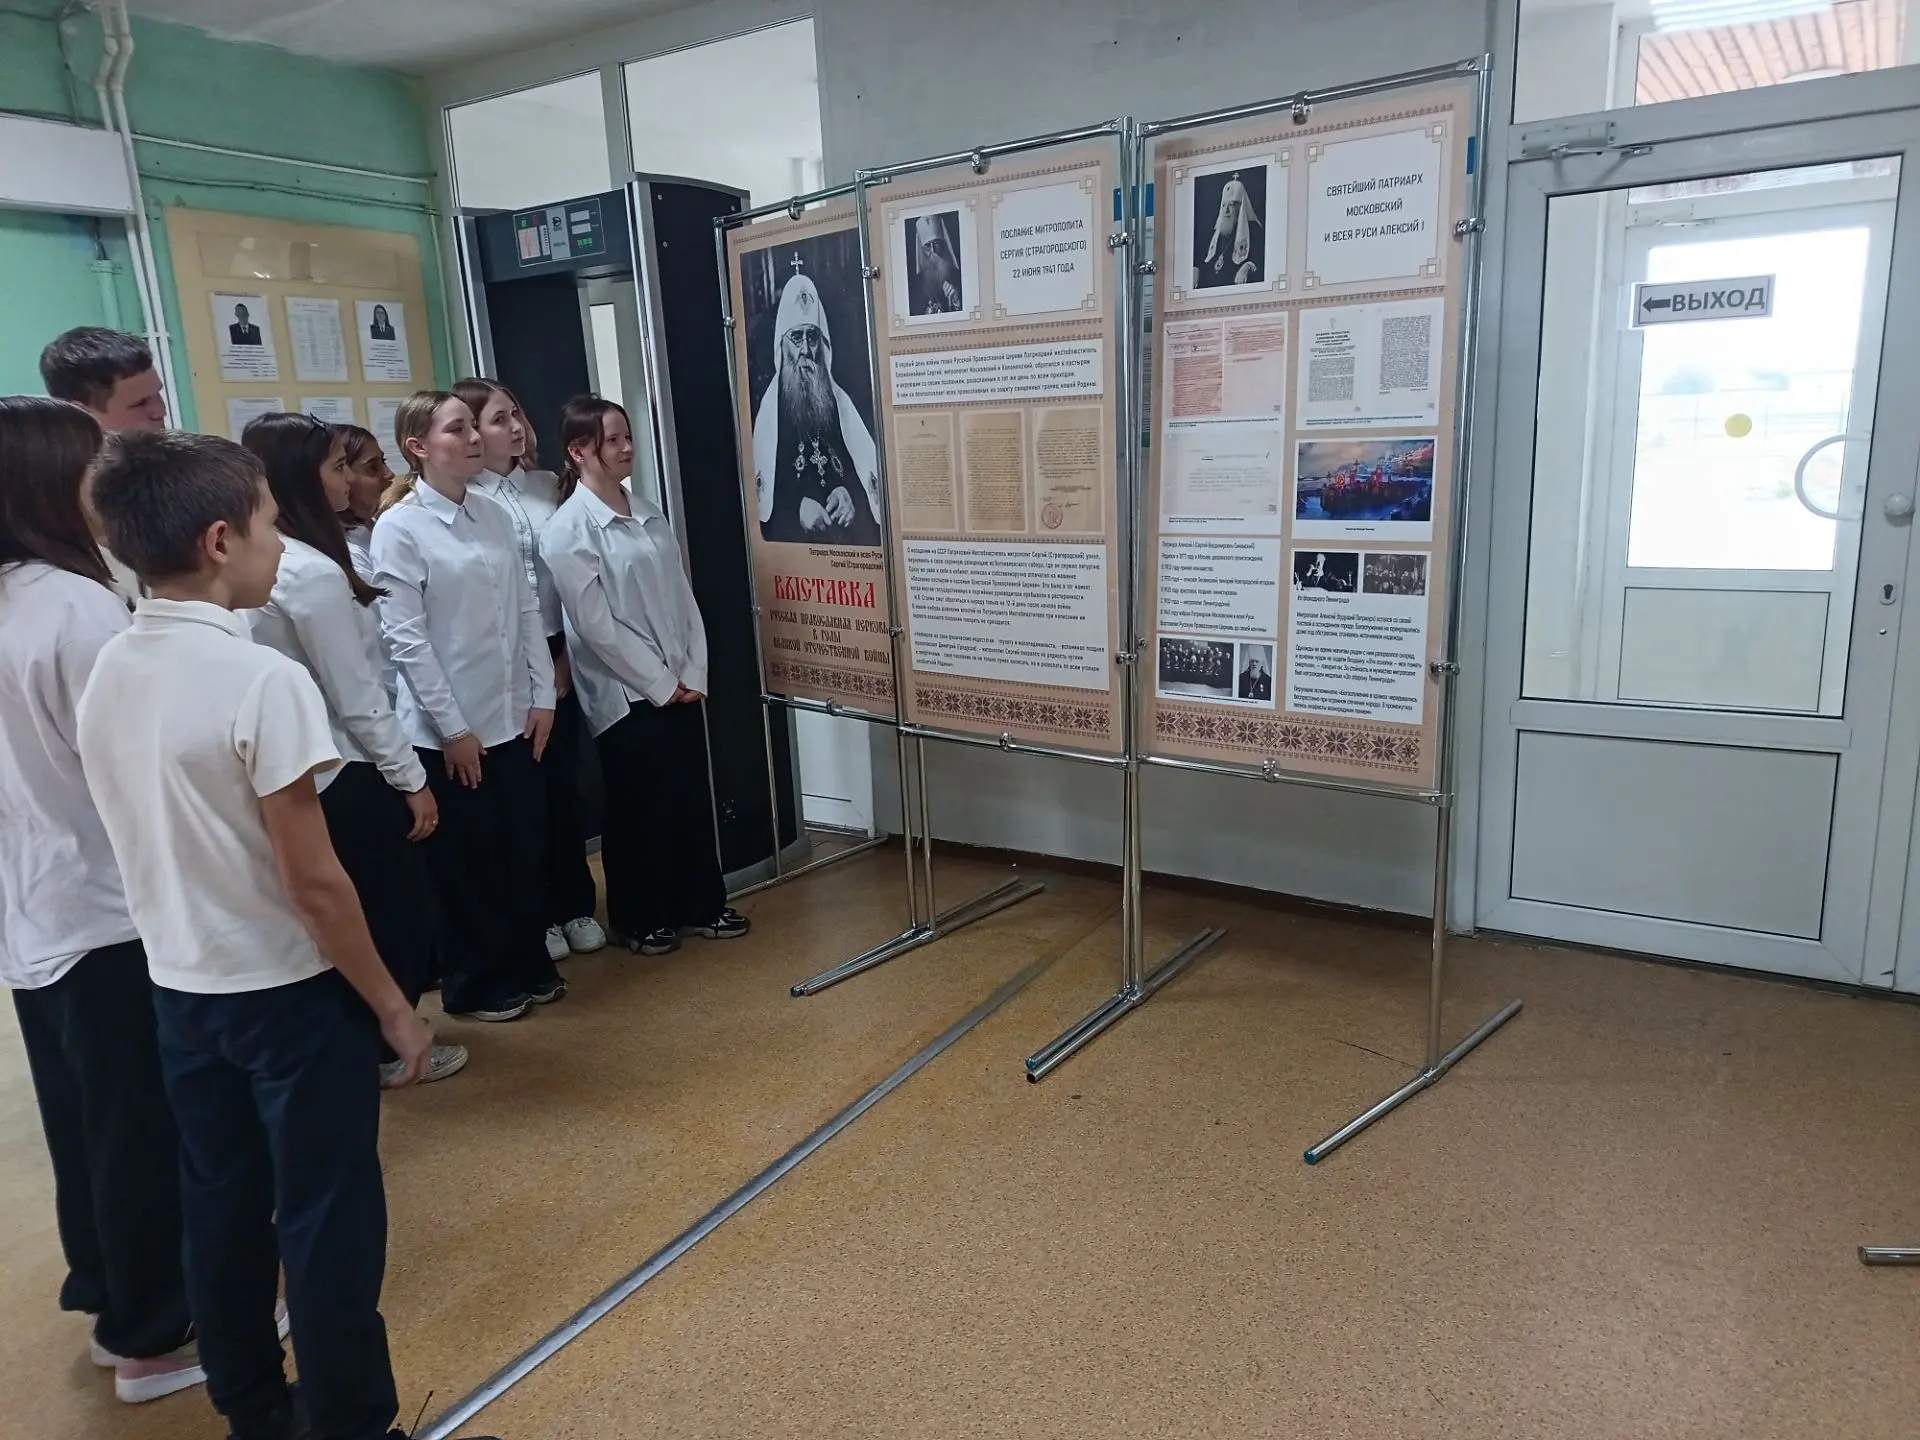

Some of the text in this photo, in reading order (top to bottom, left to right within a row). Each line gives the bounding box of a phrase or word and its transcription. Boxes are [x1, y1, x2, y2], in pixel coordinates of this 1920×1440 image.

[1326, 173, 1423, 196] СВЯТЕЙШИЙ ПАТРИАРХ
[1346, 198, 1403, 217] МОСКОВСКИЙ
[1000, 220, 1083, 239] ПОСЛАНИЕ МИТРОПОЛИТА
[1324, 233, 1330, 242] И
[1332, 230, 1352, 242] ВСЕЯ
[1355, 226, 1378, 238] РУСИ
[1380, 219, 1419, 235] АЛЕКСИЙ
[1000, 240, 1086, 260] СЕРГИЯ (СТРАГОРОДСКОГО)
[1012, 262, 1074, 278] 22 ИЮНЯ 1941 ГОДА
[1671, 287, 1765, 312] ВЫХОД
[954, 356, 971, 365] Русской
[973, 353, 1004, 364] Православной
[1006, 352, 1022, 361] Церкви
[970, 364, 996, 373] Московский
[1035, 361, 1060, 370] обратился
[829, 549, 856, 557] Московский
[831, 560, 846, 568] Сергий
[774, 575, 876, 608] ВЫСТАВКА
[800, 613, 851, 630] ПРАВОСЛАВНАЯ
[856, 619, 889, 634] ЦЕРКОВЬ
[821, 630, 841, 643] ГОДЫ
[773, 636, 890, 664] ВЕЛИКОЙ ОТЕЧЕСТВЕННОЙ ВОЙНЫ
